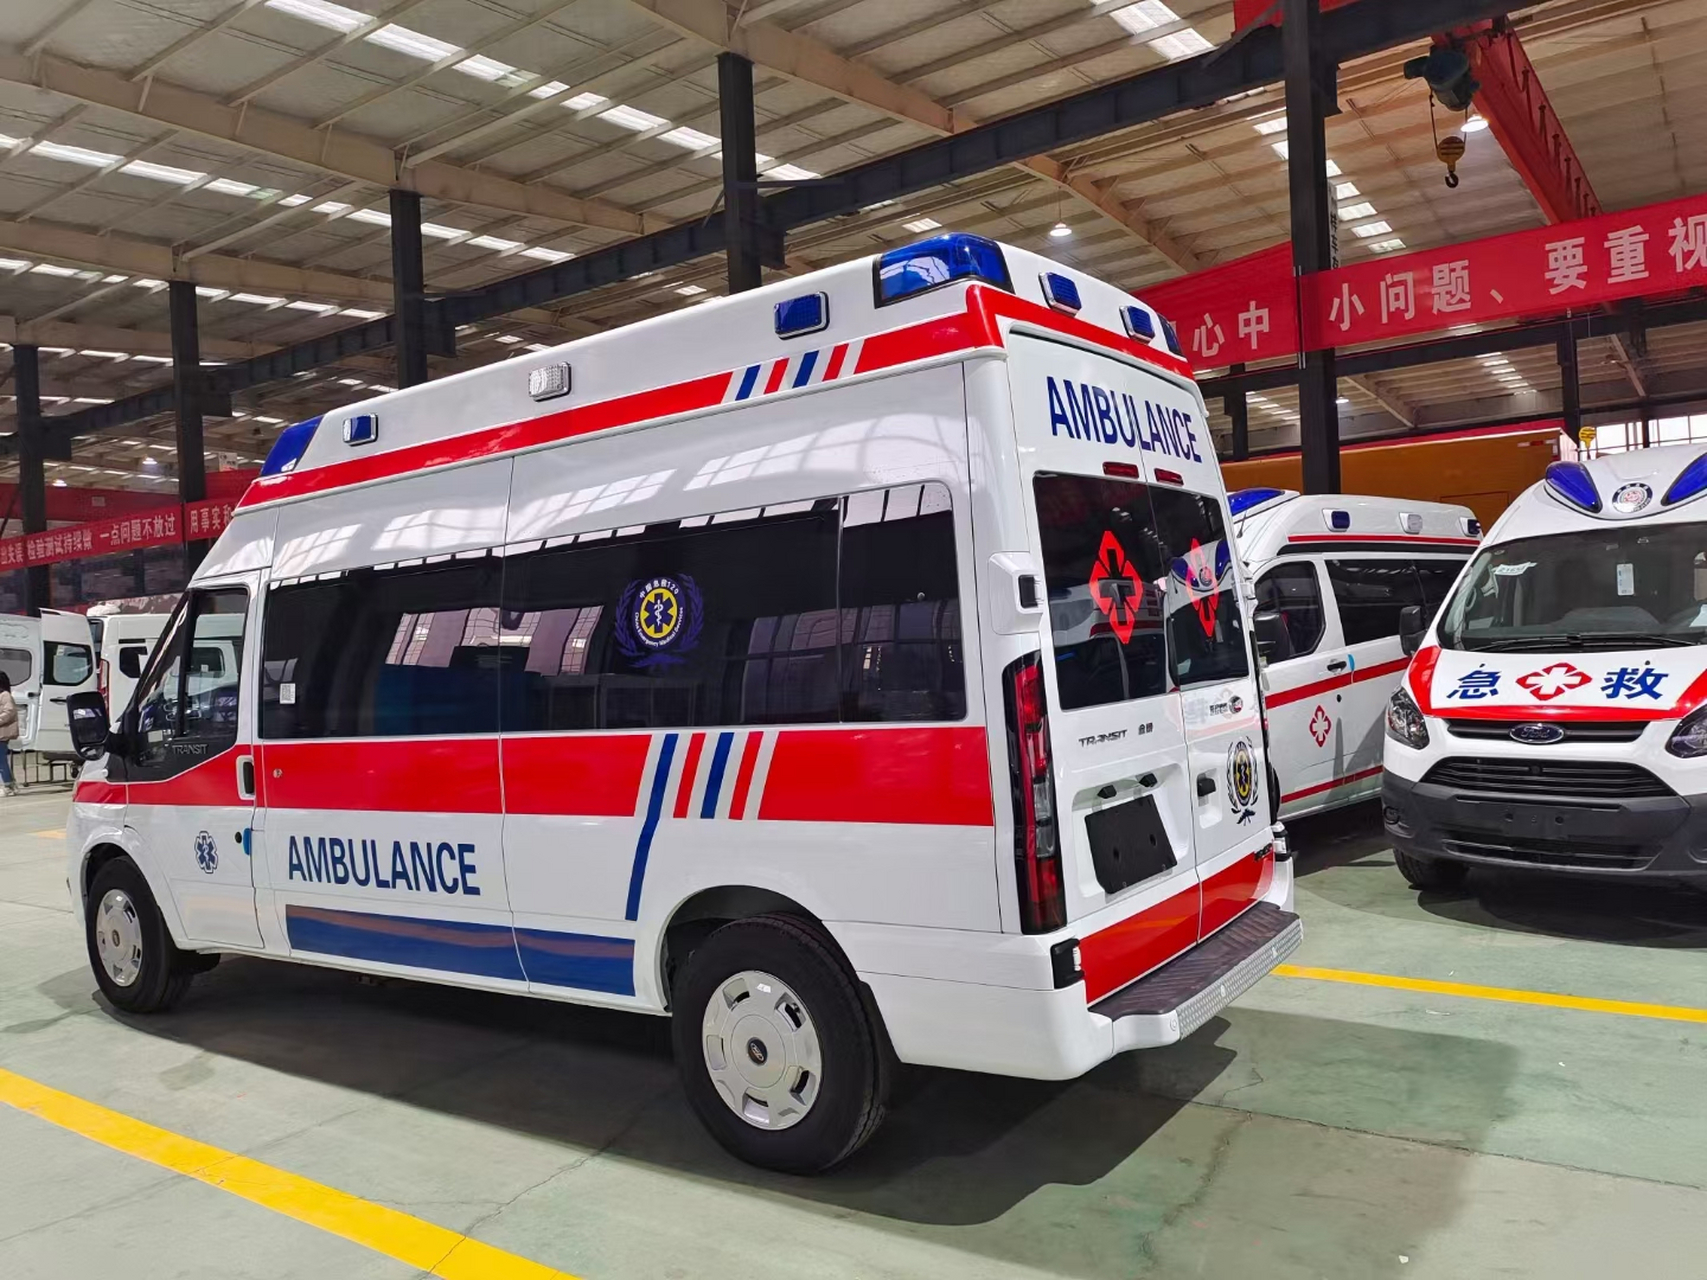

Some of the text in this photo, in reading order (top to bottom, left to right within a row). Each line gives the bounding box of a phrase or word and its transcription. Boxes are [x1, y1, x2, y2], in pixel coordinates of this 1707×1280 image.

[1328, 213, 1707, 332] 小问题、要重视
[1169, 300, 1269, 357] 心中
[1047, 376, 1202, 463] AMBULANCE
[100, 512, 176, 546] 一点问题不放过
[171, 743, 208, 754] TRANSIT
[1079, 728, 1128, 747] TRANSIT
[1520, 725, 1551, 738] Ford
[288, 835, 481, 896] AMBULANCE
